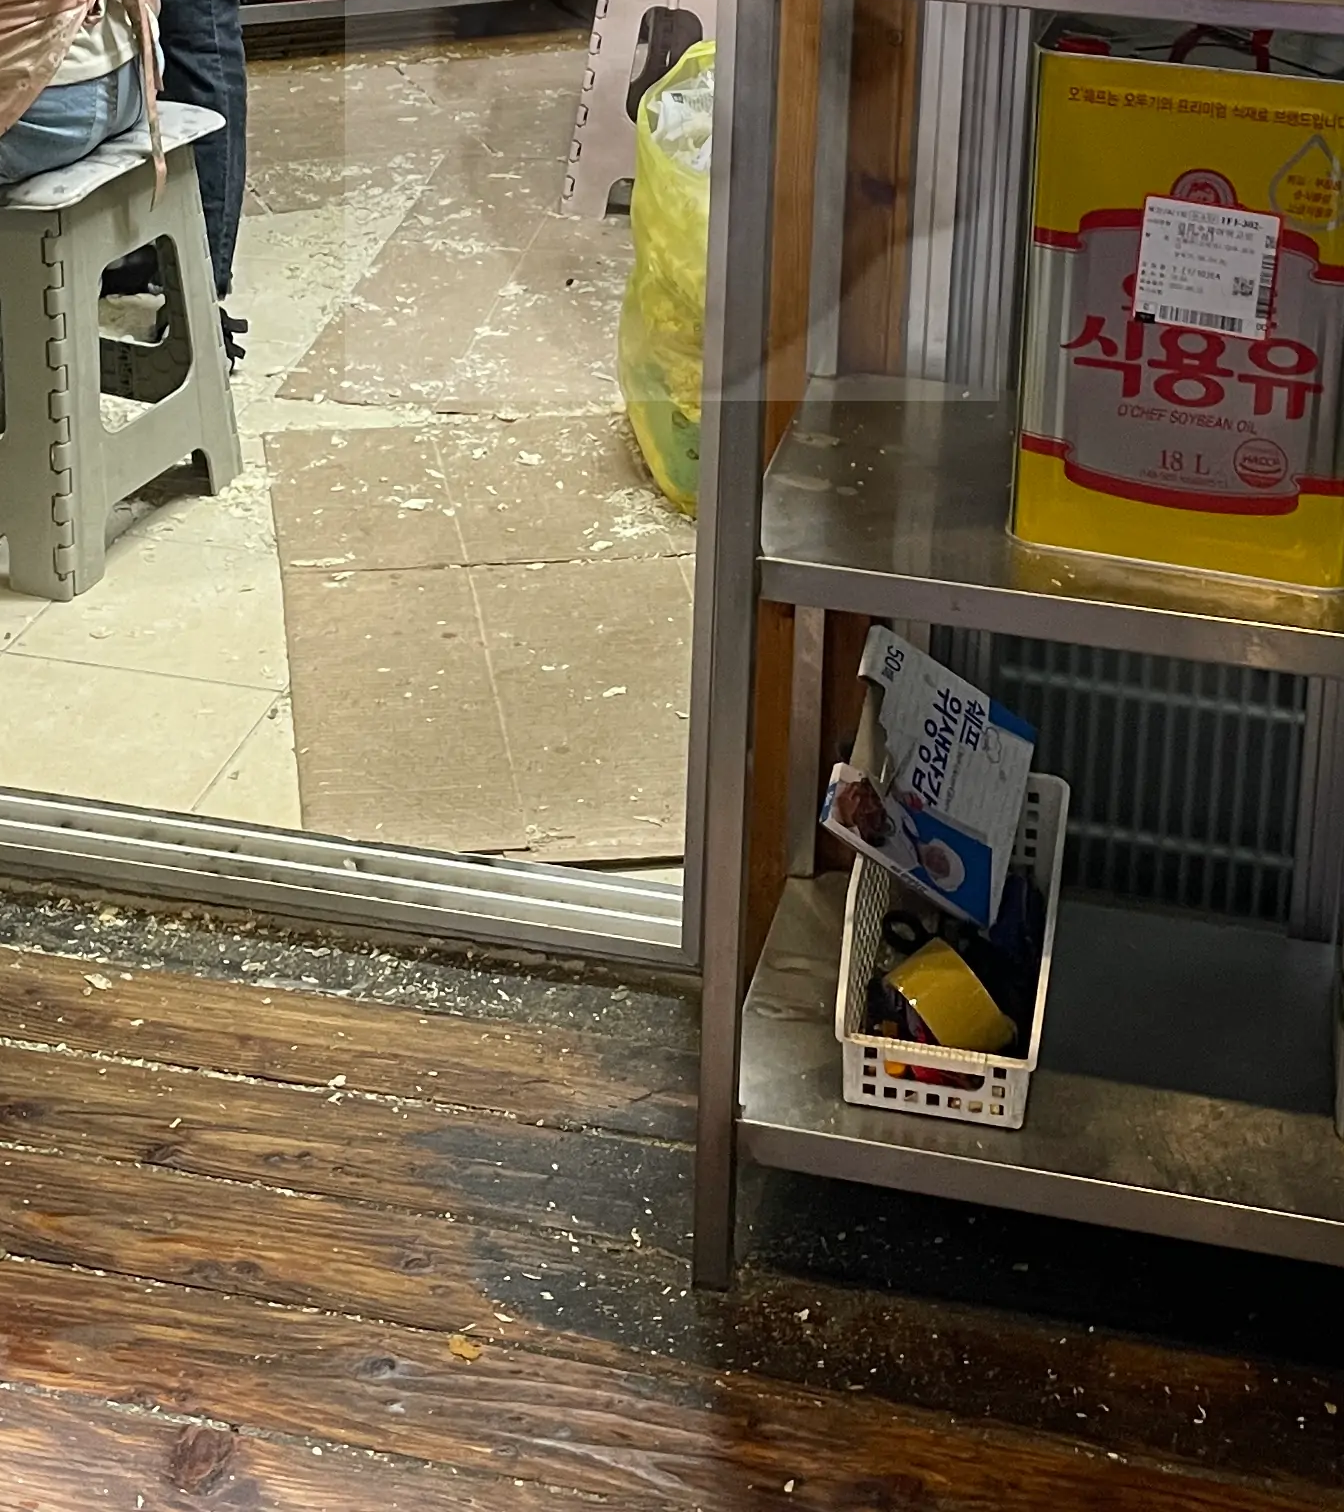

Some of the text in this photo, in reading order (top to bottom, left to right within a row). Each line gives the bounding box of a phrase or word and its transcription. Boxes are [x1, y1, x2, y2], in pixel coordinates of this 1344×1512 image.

[1061, 314, 1325, 421] 식용유
[1169, 410, 1232, 431] SOYBEAN
[1159, 449, 1210, 475] 18 L
[910, 687, 962, 807] 위생장갑
